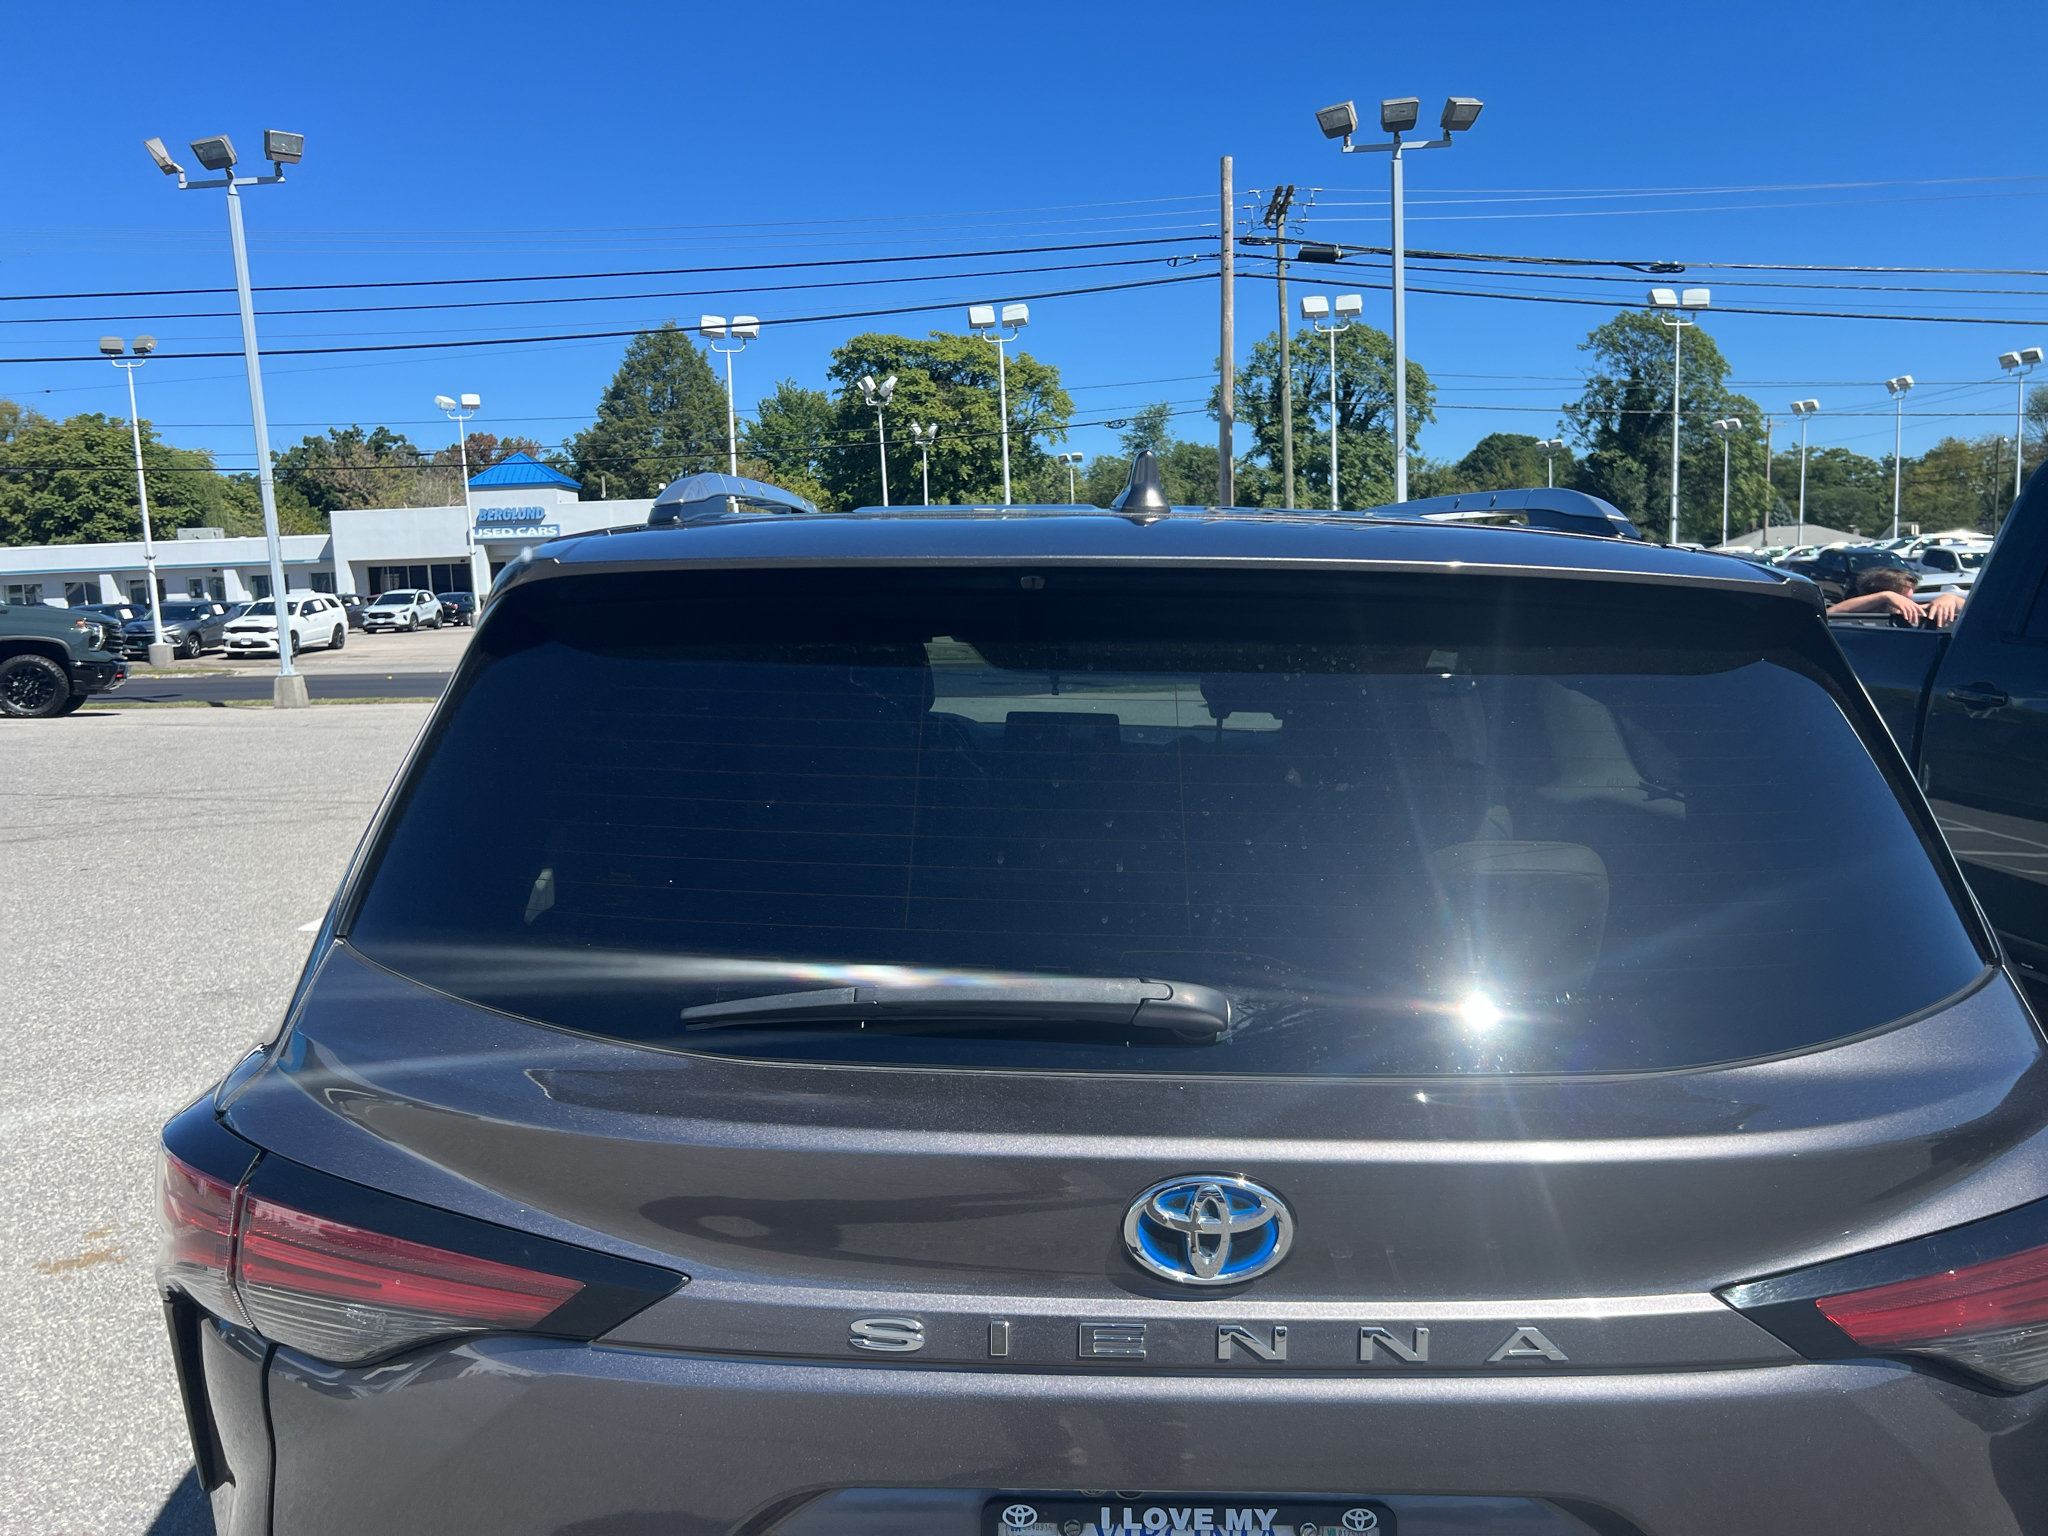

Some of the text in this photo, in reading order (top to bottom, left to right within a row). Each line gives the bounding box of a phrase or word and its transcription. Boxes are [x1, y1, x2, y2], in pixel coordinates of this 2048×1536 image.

[478, 507, 545, 521] BERGLUND
[472, 526, 558, 538] USED CARS
[847, 1315, 1569, 1364] SIENNA
[1100, 1506, 1111, 1529] I
[1123, 1506, 1214, 1531] LOVE
[1225, 1508, 1278, 1531] MY
